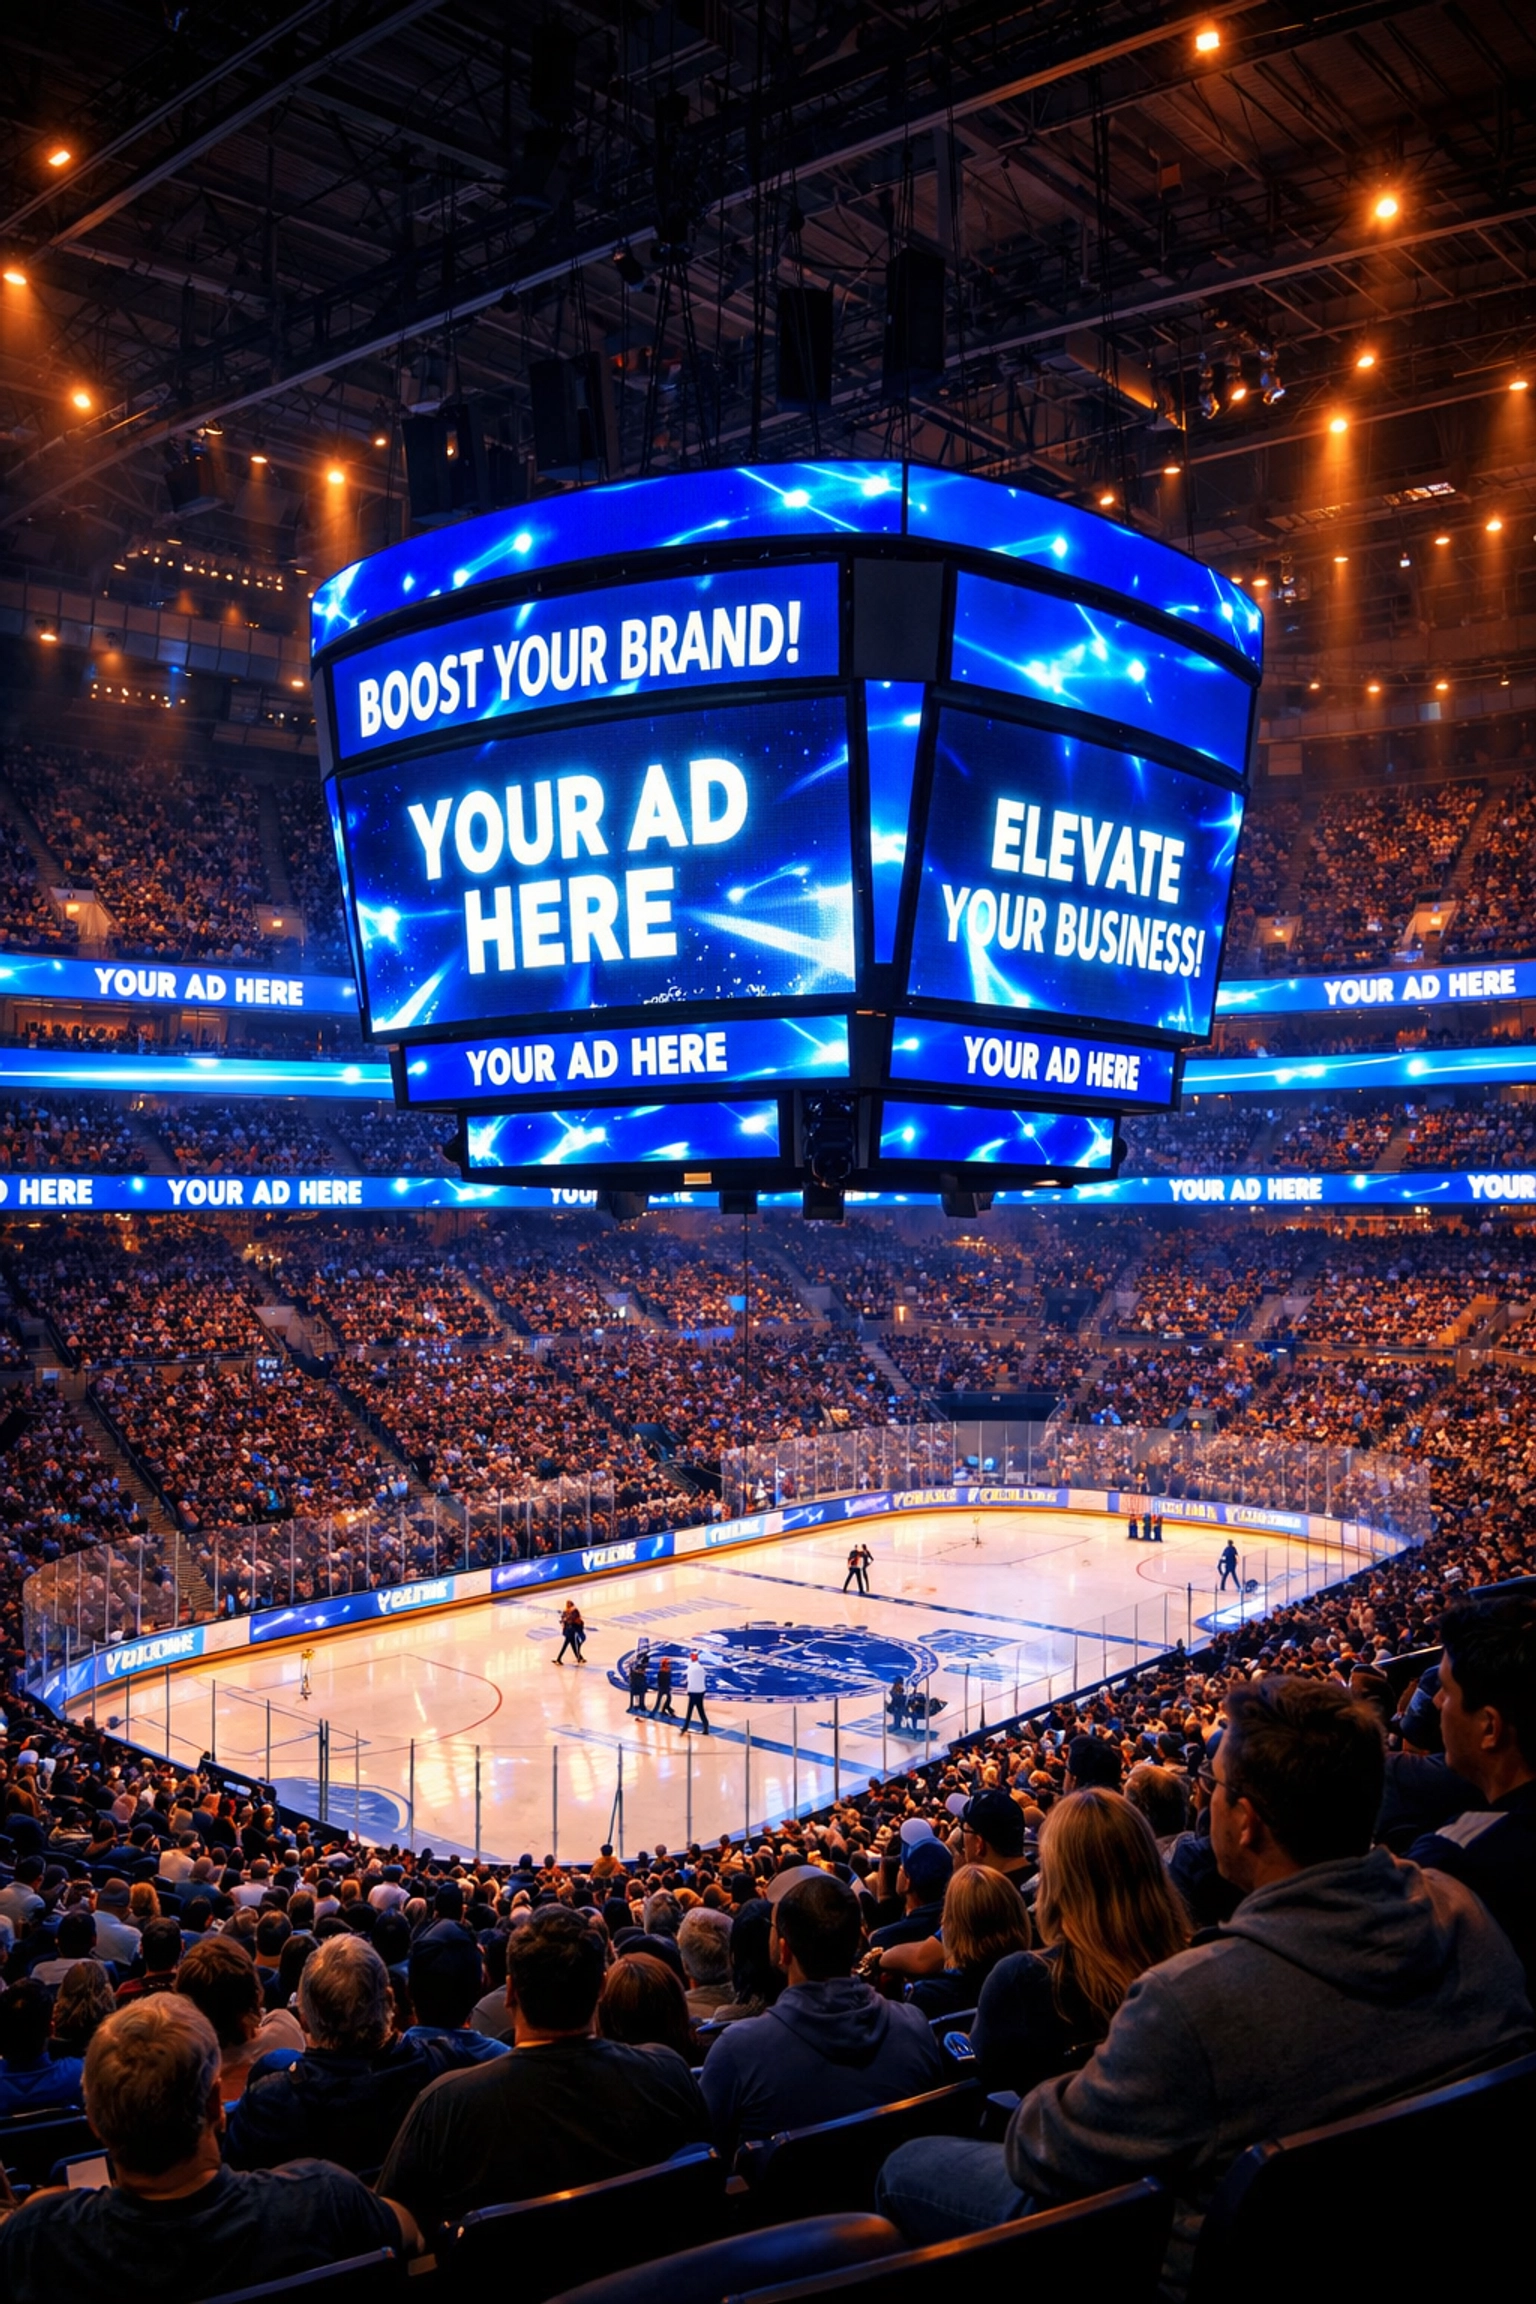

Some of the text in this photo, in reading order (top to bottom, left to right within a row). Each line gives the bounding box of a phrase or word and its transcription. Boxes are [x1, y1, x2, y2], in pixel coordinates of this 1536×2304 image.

[359, 600, 801, 738] BOOST YOUR BRAND!
[407, 758, 748, 880] YOUR AD
[991, 798, 1185, 904] ELEVATE
[464, 867, 678, 975] HERE
[942, 884, 1206, 978] YOUR BUSINESS!
[94, 967, 304, 1006] YOUR AD HERE
[1323, 968, 1517, 1006] YOUR AD HERE
[466, 1031, 728, 1086] YOUR AD HERE
[964, 1036, 1140, 1091] YOUR AD HERE
[19, 1178, 93, 1205] HERE
[167, 1179, 362, 1205] YOUR AD HERE
[1169, 1177, 1323, 1202] YOUR AD HERE
[1467, 1174, 1536, 1199] YOUR
